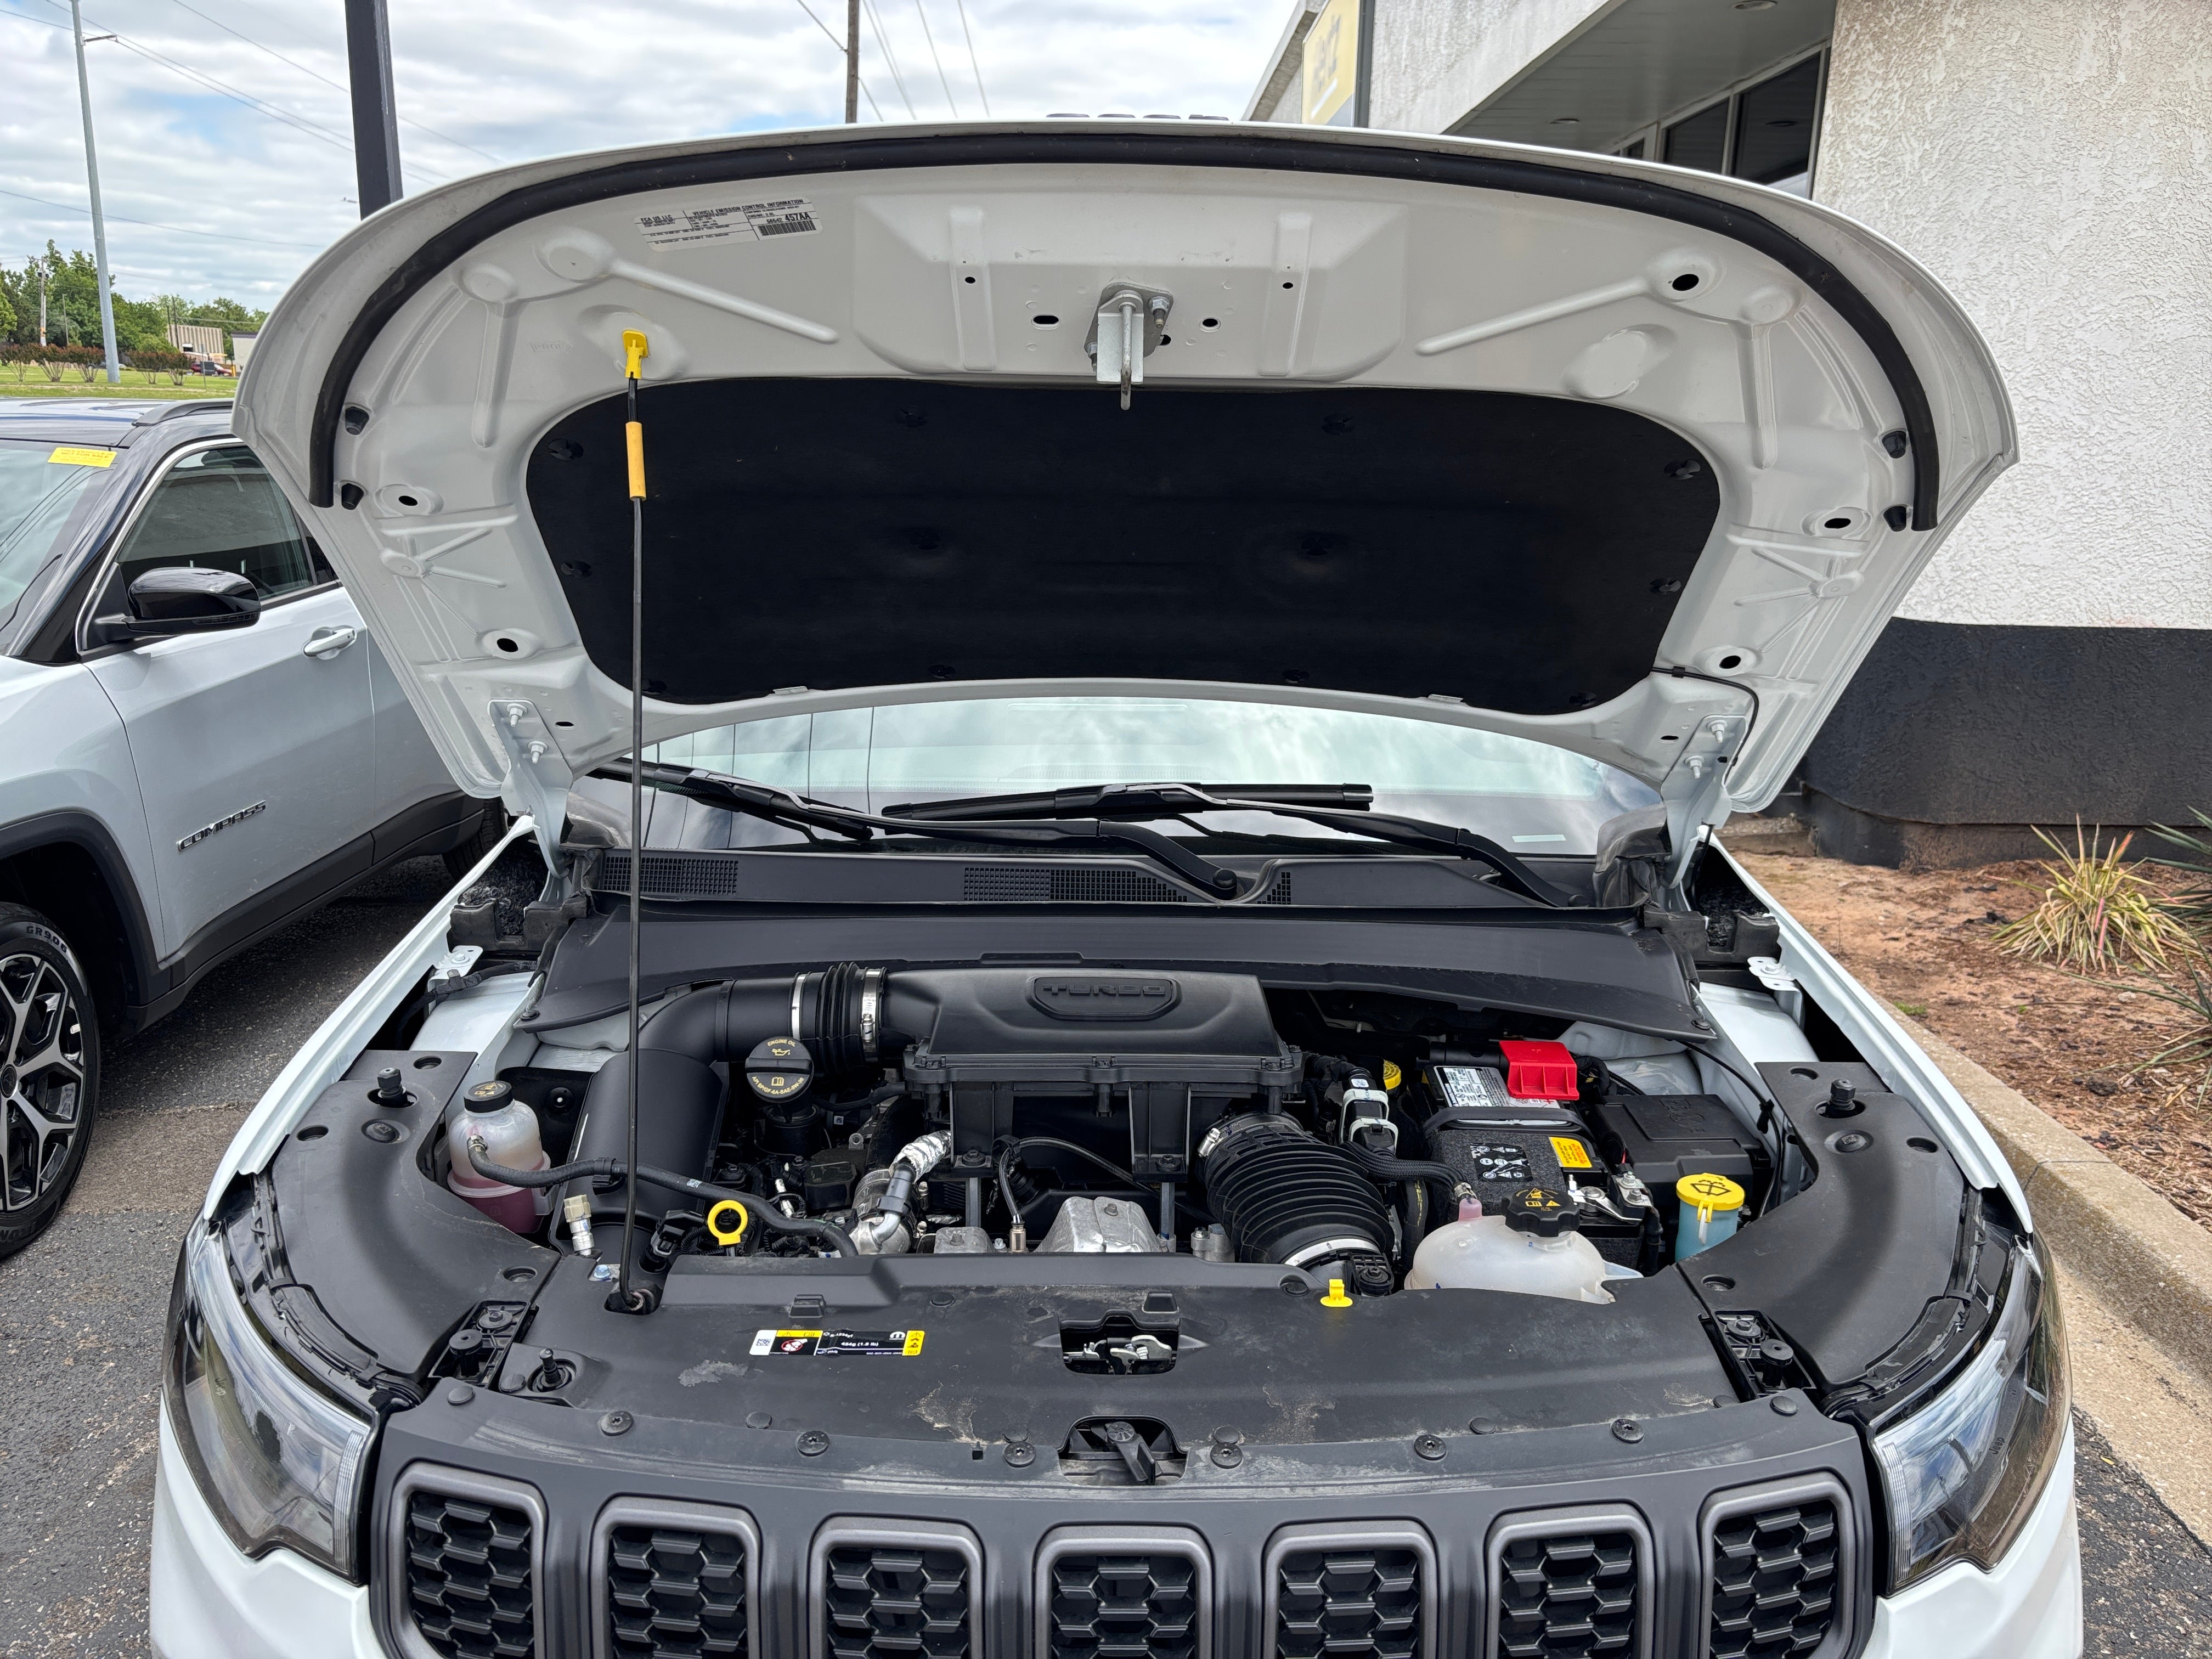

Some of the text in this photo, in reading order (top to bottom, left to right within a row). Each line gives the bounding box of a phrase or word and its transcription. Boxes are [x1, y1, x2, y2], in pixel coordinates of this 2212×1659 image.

[767, 199, 804, 207] INFORMATION
[785, 212, 811, 222] 457AA
[176, 799, 266, 851] COMPASS
[26, 926, 67, 953] GR906
[1043, 983, 1166, 996] TURBO
[1988, 1437, 2006, 1455] Jeep
